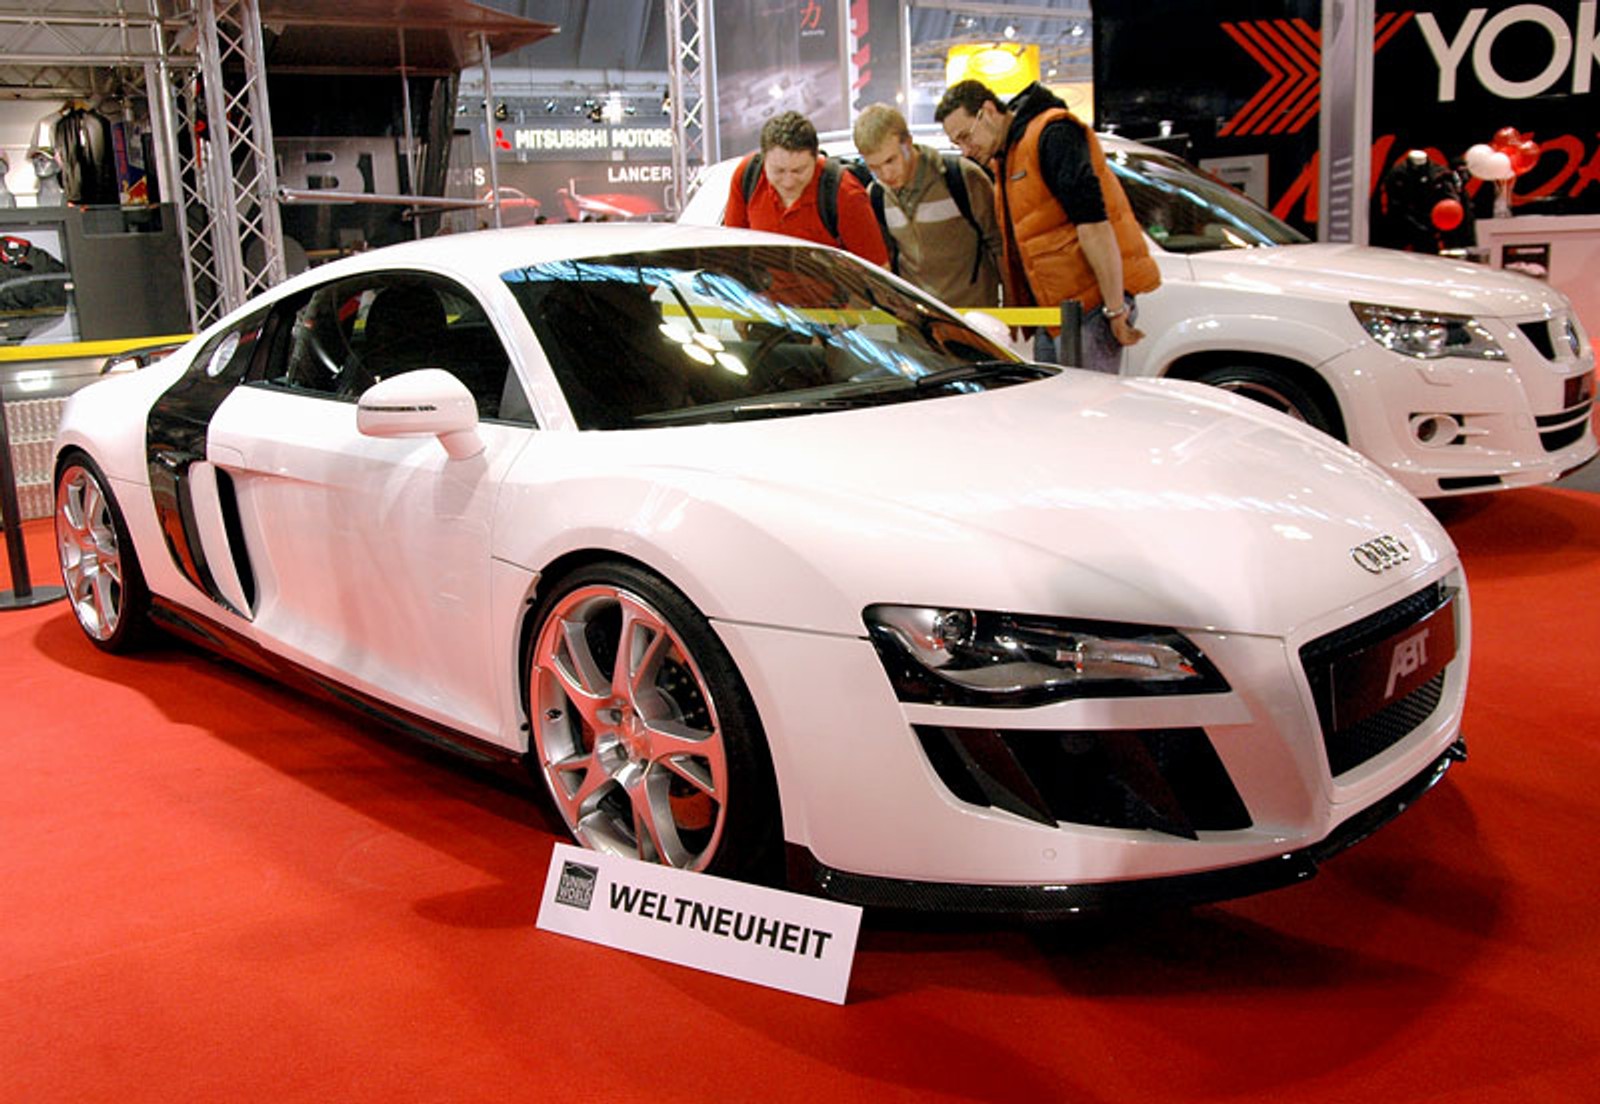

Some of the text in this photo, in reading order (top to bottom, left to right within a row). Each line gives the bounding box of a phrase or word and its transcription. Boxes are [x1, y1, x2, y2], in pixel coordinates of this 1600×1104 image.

[515, 128, 608, 149] MITSUBISHI
[607, 166, 672, 183] LANCER
[1384, 627, 1430, 699] ABT
[609, 882, 833, 960] WELTNEUHEIT
